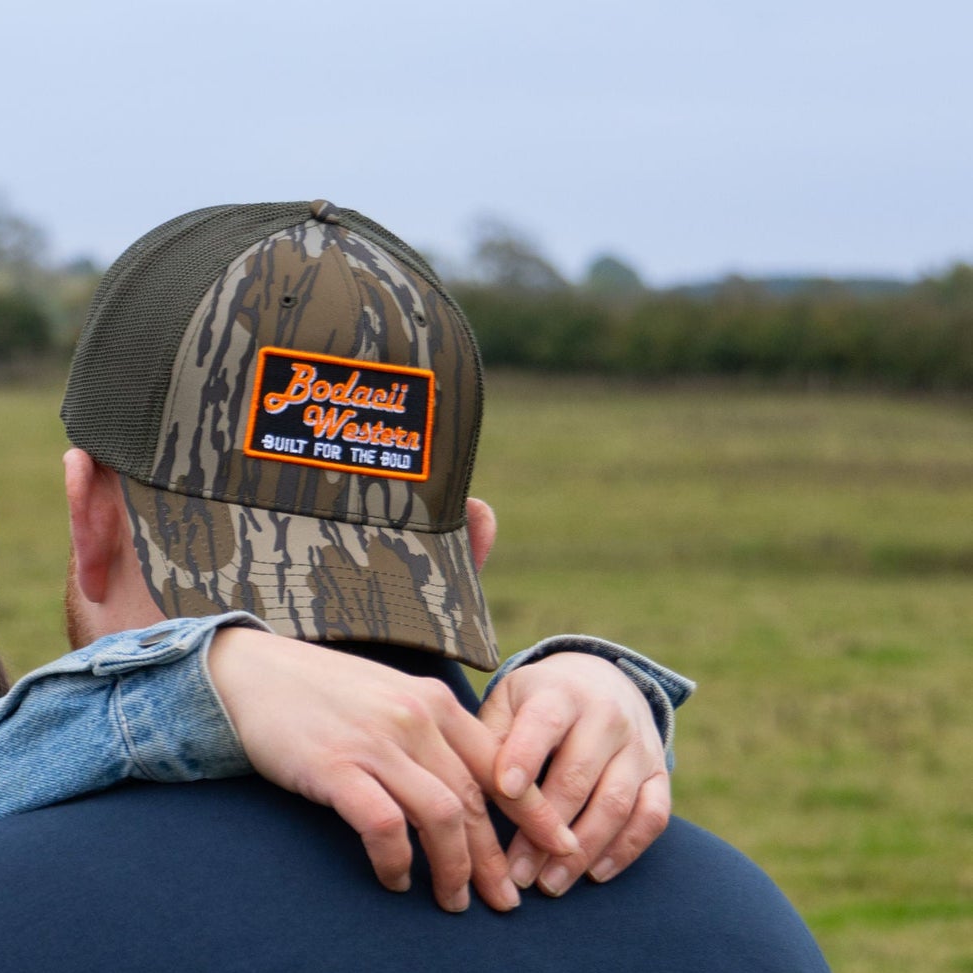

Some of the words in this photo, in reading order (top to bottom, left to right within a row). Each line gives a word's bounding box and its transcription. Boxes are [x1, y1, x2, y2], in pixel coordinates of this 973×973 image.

[263, 363, 409, 414] Bodacii
[303, 404, 421, 451] Western
[261, 434, 309, 454] BUILT
[313, 442, 342, 460] FOR
[350, 447, 376, 465] THE
[380, 451, 412, 469] BOLD
